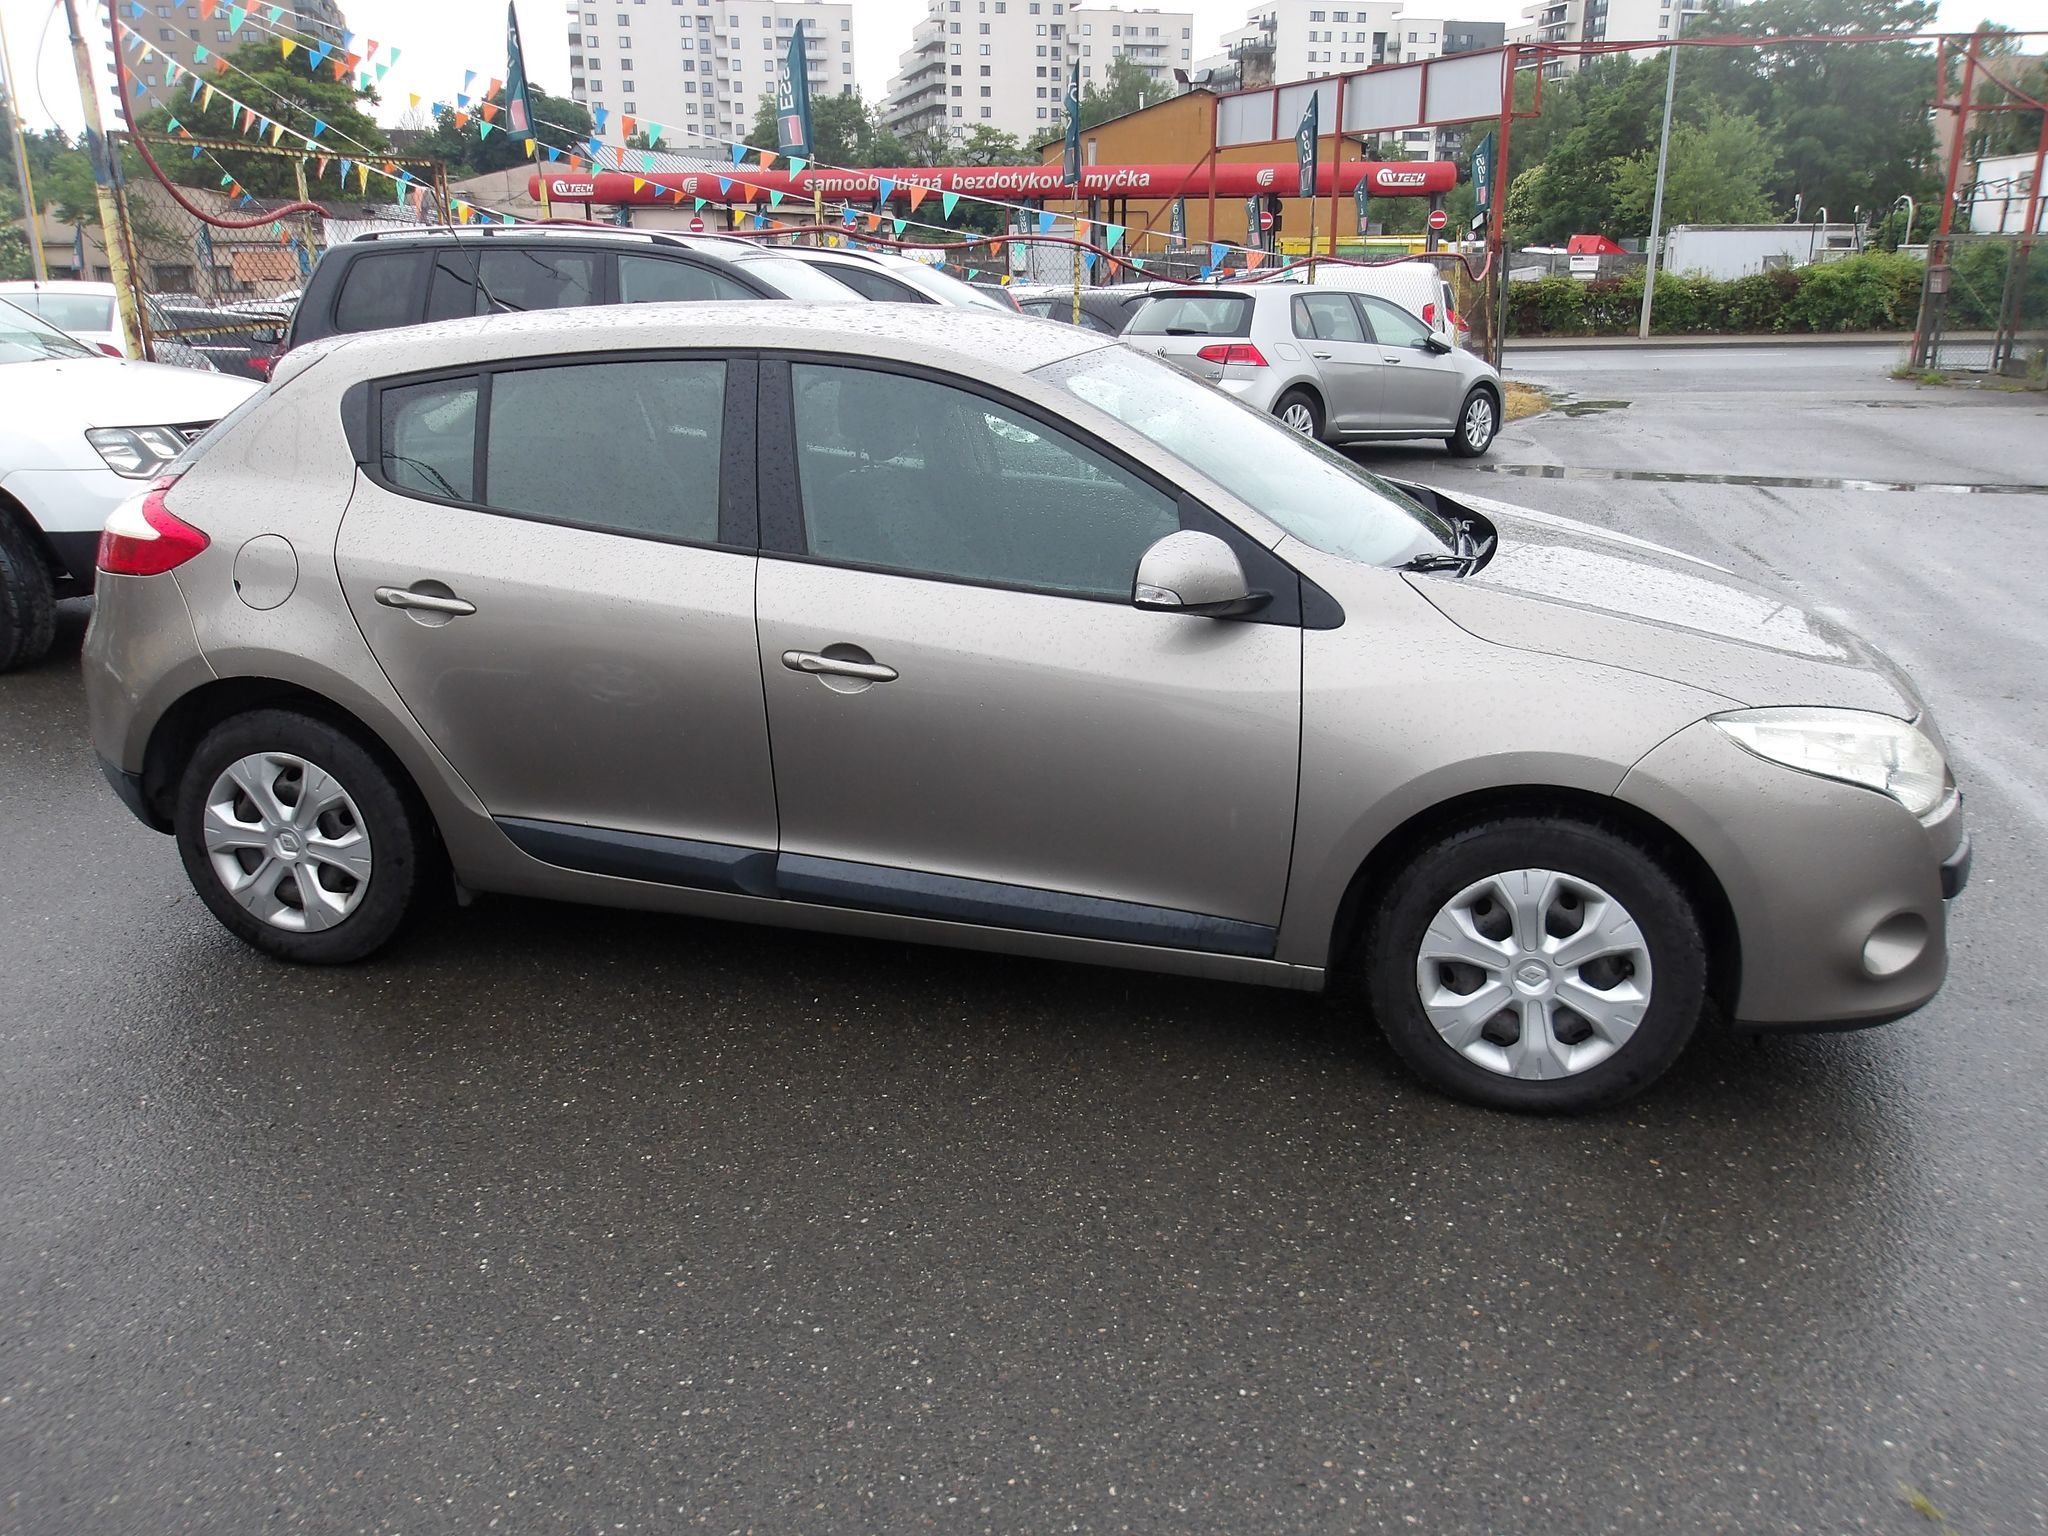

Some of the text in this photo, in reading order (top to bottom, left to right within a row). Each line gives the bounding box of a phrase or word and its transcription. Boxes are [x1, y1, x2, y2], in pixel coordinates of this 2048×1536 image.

[803, 170, 1150, 192] samooblužná bezdotykov myčka
